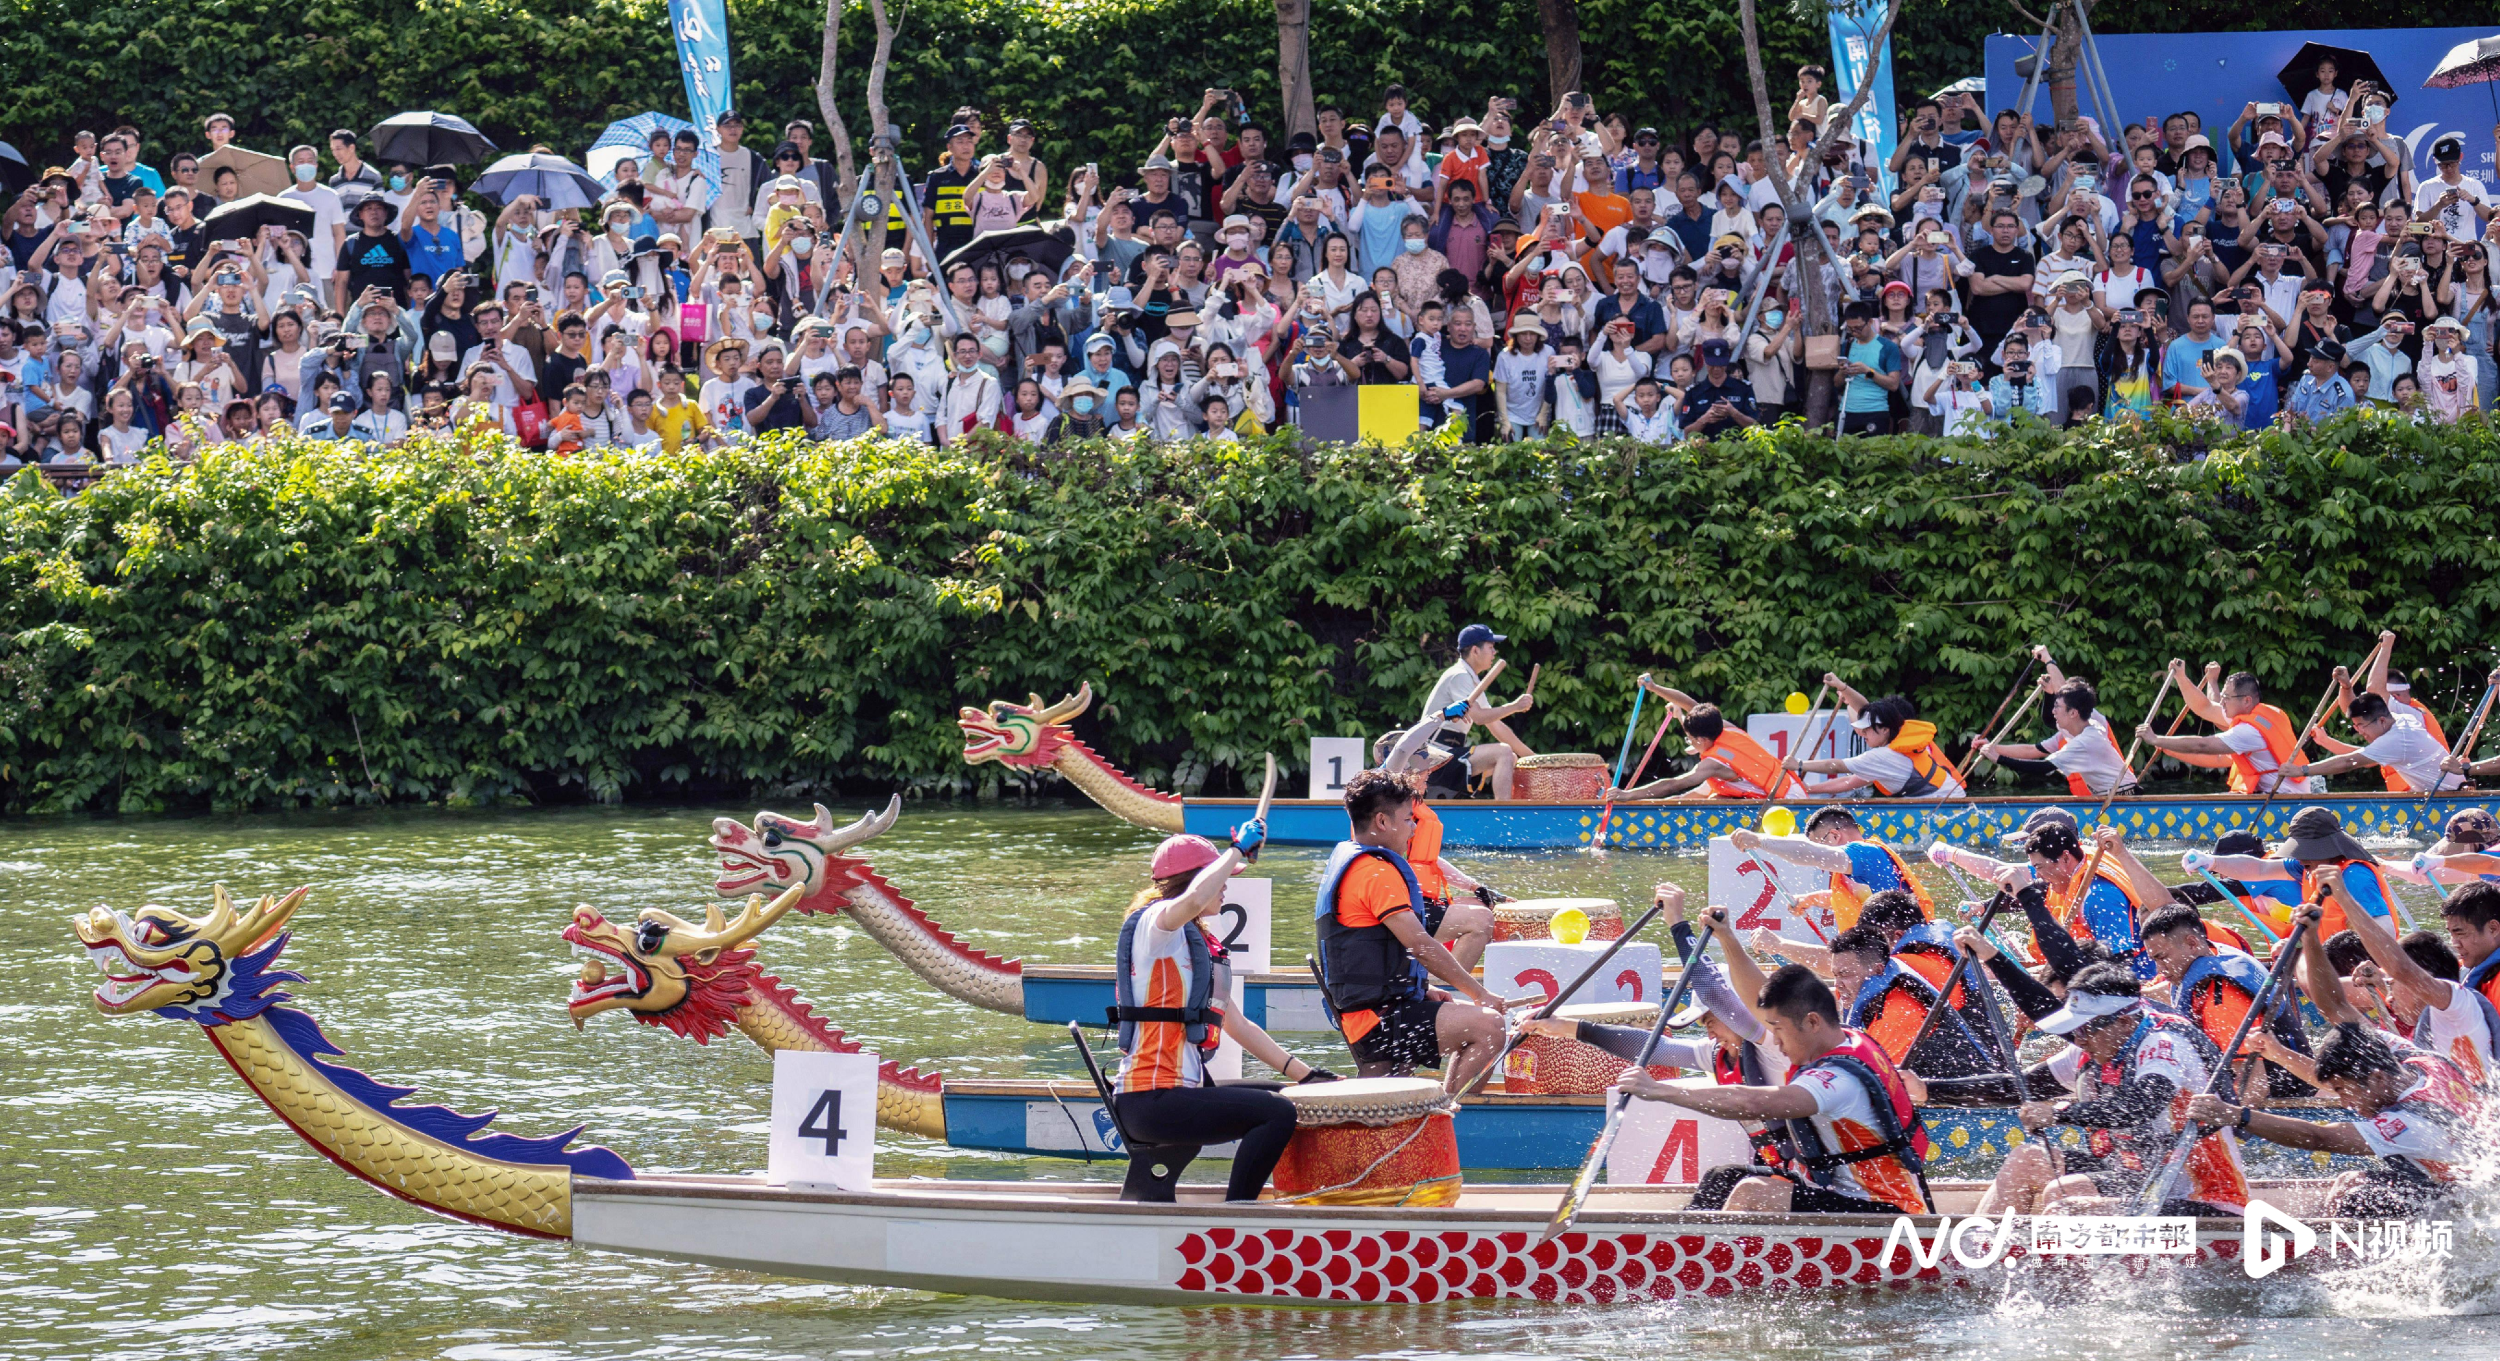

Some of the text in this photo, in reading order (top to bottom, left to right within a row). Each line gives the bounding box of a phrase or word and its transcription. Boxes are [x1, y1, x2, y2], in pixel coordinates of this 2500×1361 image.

[1326, 756, 1347, 790] 1
[1736, 859, 1781, 930] 2
[1220, 903, 1249, 952] 2
[1685, 935, 1730, 990] SORTS
[798, 1089, 847, 1157] 4
